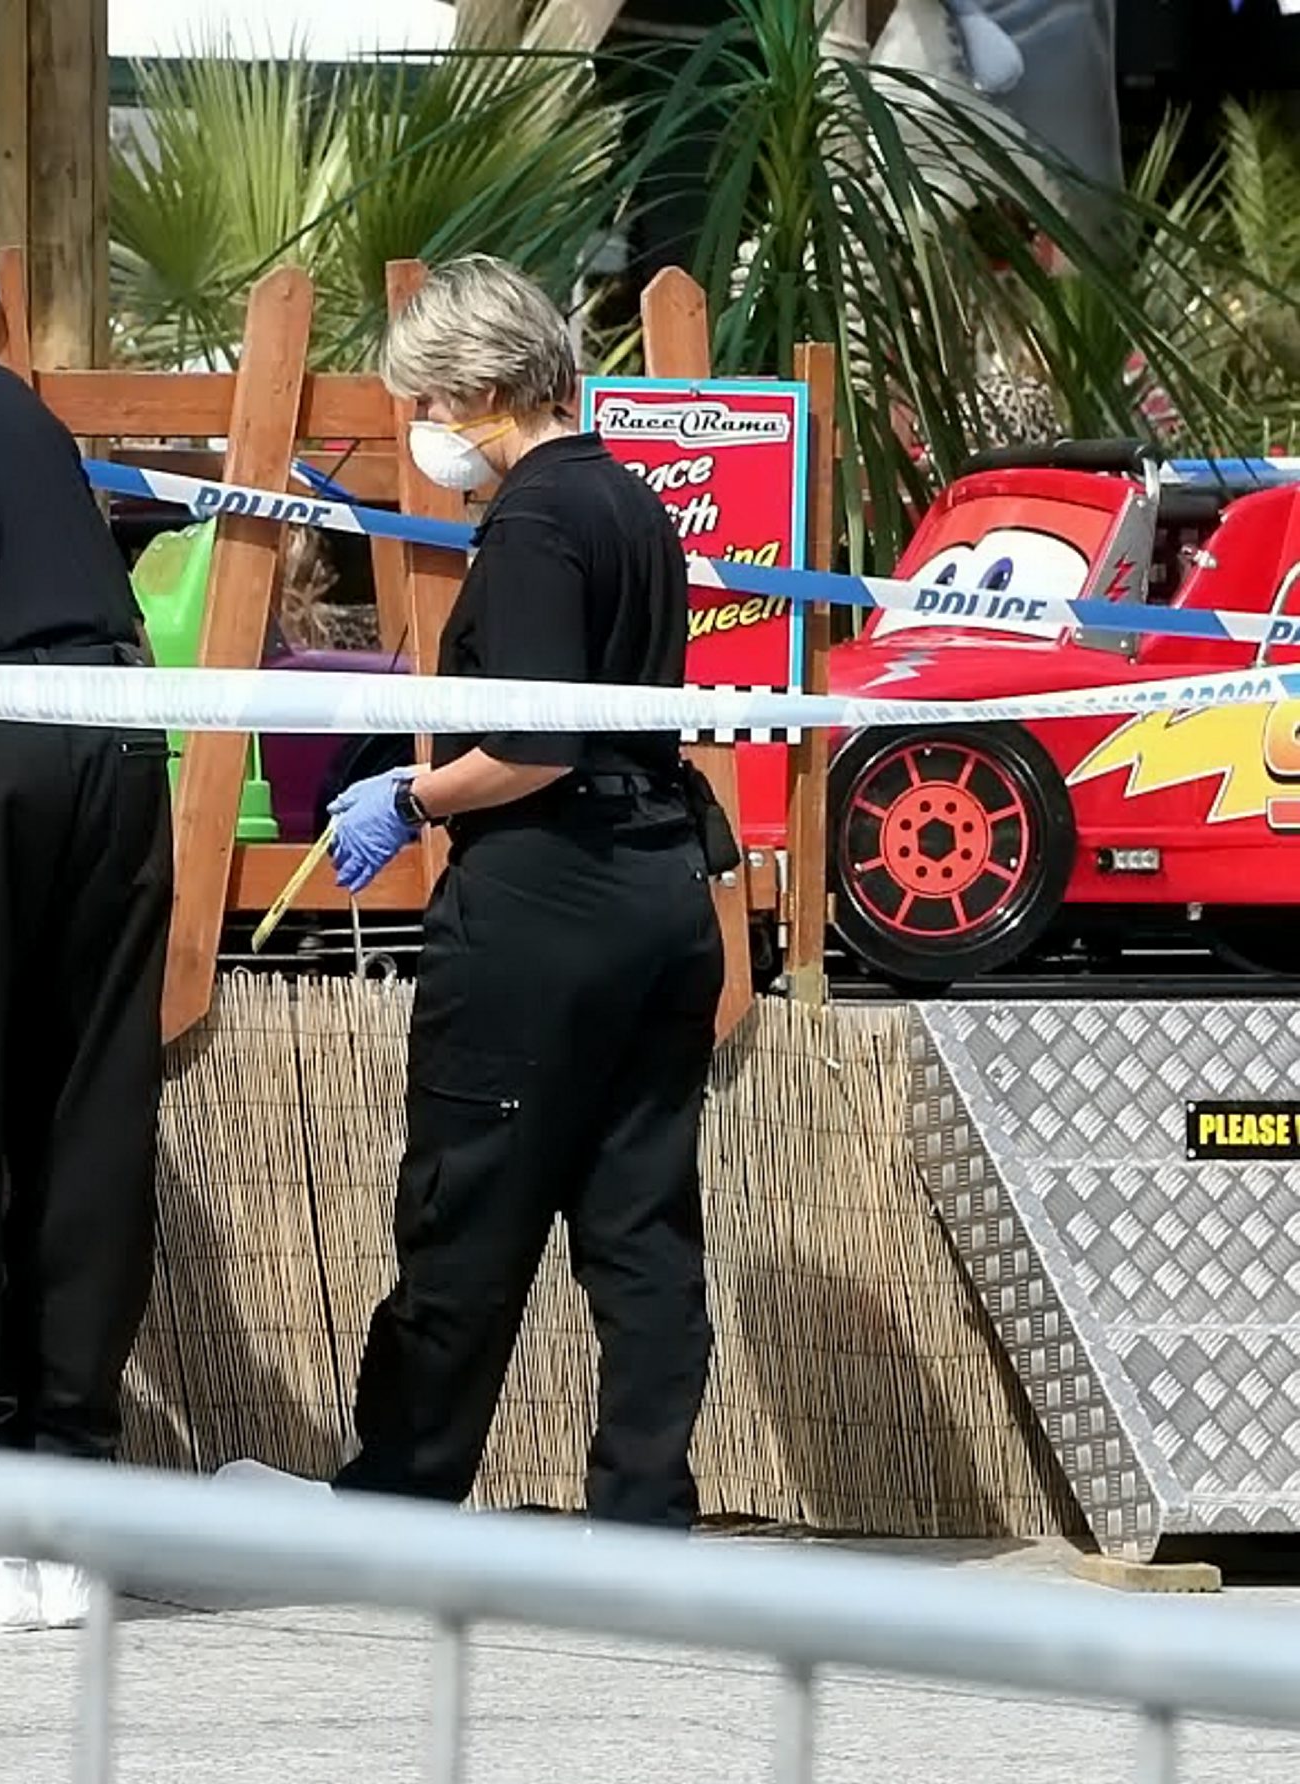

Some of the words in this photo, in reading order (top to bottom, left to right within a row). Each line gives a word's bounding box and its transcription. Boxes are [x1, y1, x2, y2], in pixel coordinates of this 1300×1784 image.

[608, 407, 677, 431] Race
[701, 409, 781, 432] Rama
[1199, 1113, 1291, 1146] PLEASE
